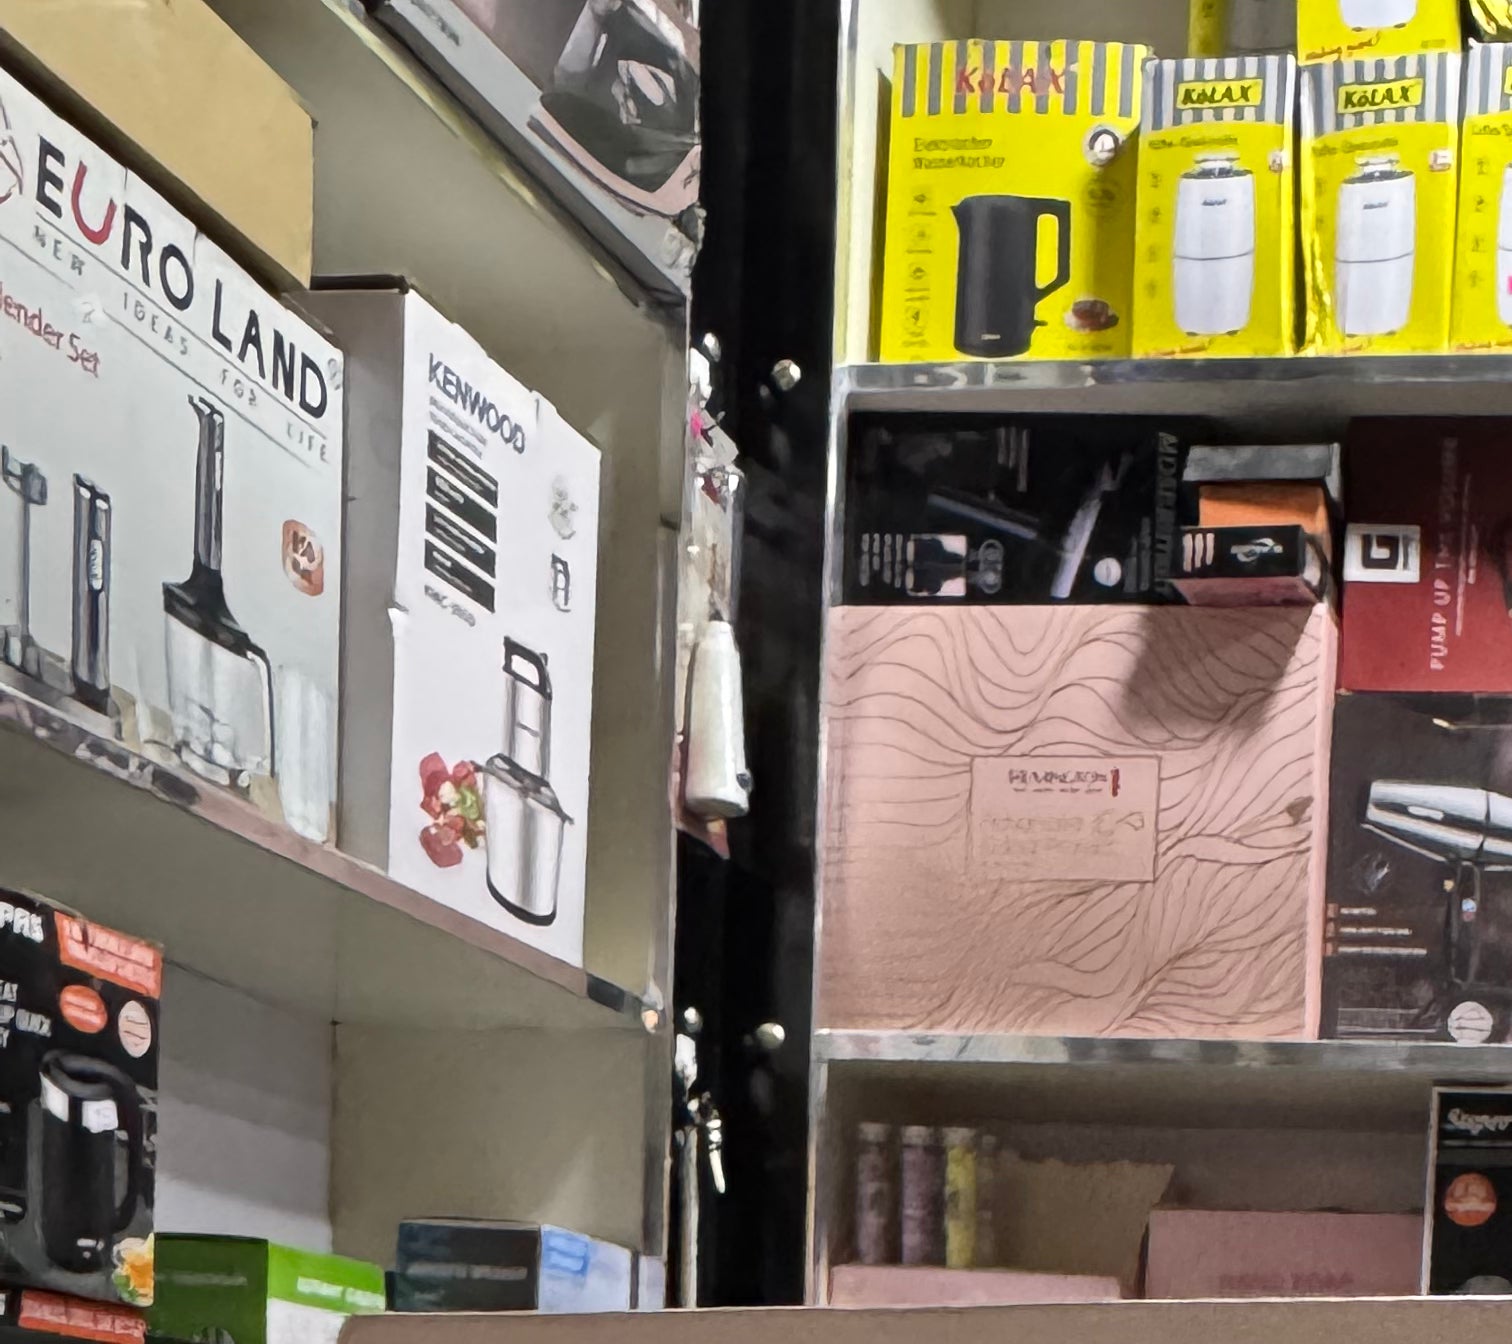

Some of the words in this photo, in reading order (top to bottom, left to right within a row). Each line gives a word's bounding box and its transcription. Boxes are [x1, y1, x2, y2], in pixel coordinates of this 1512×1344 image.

[36, 133, 196, 312] EURO
[211, 277, 329, 420] LAND
[428, 352, 526, 454] KENWOOD
[1433, 576, 1452, 607] UP
[1430, 610, 1451, 672] PUMP
